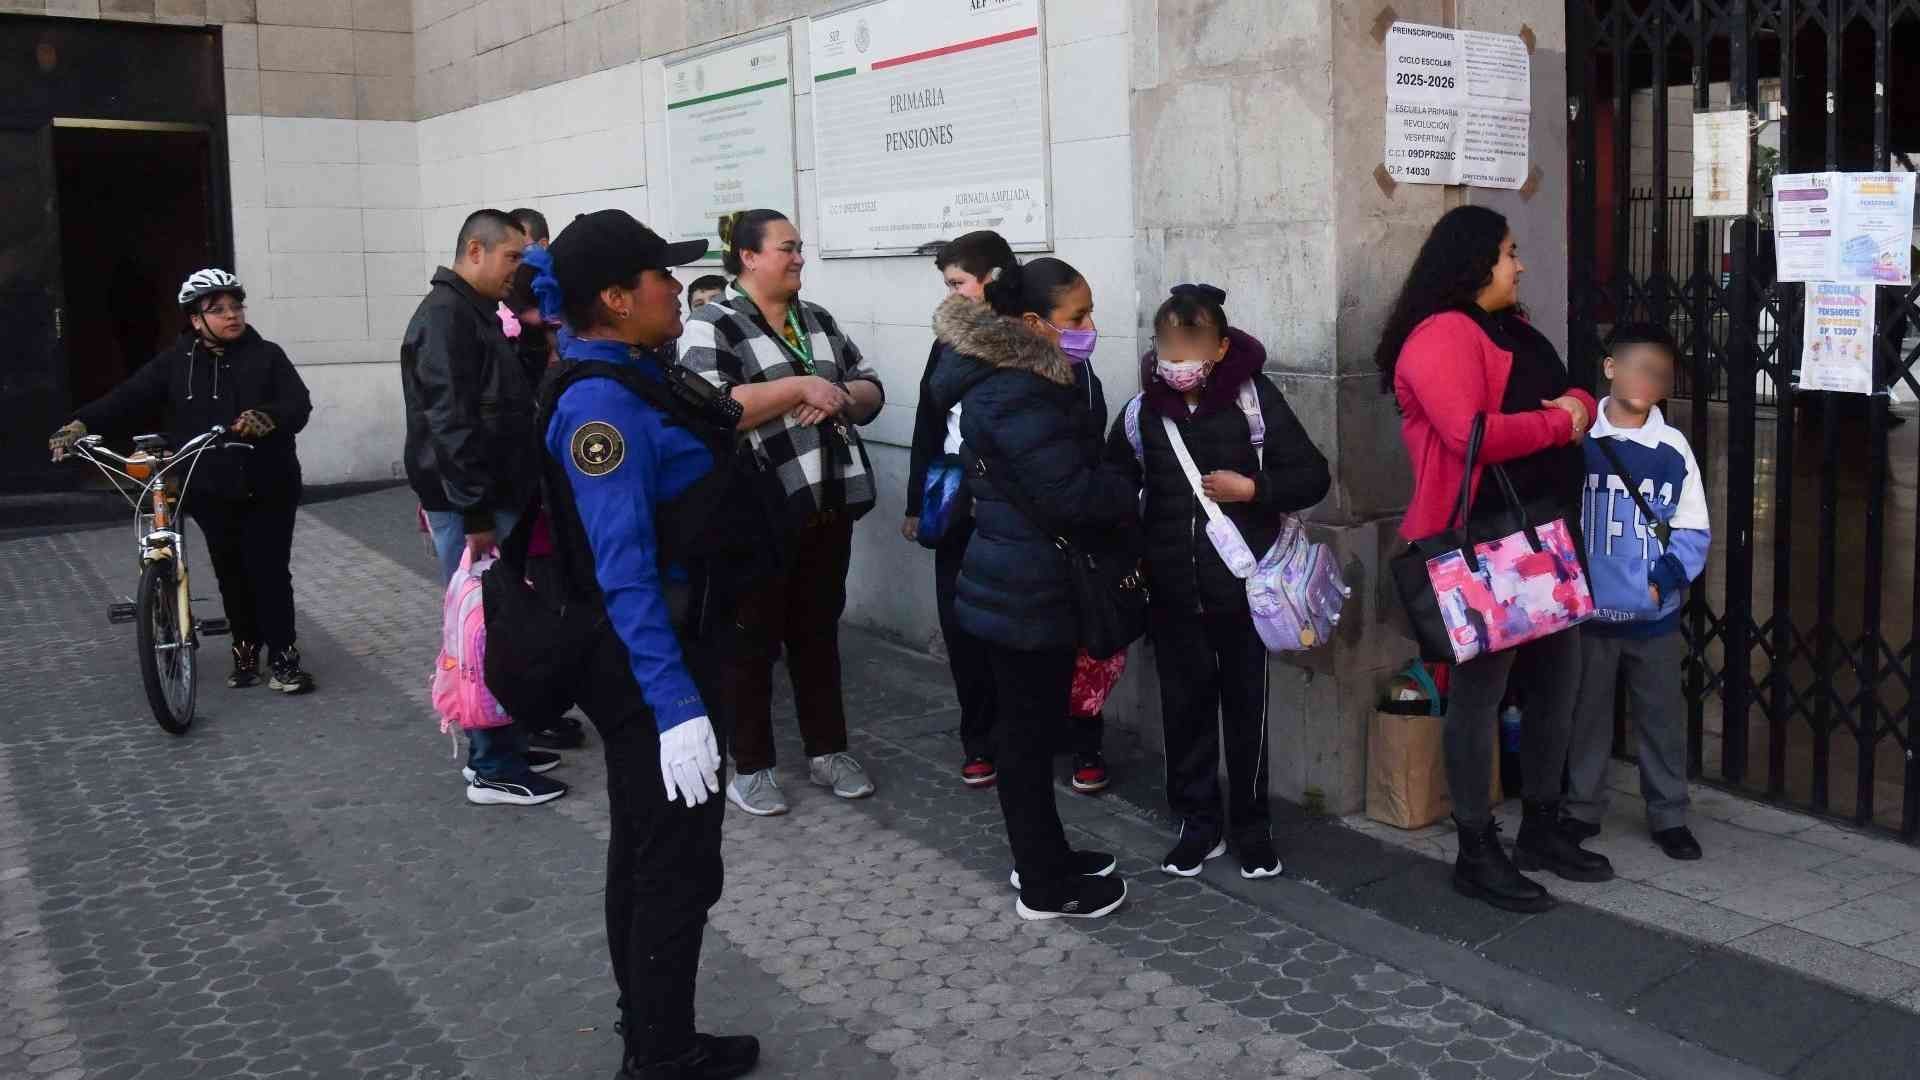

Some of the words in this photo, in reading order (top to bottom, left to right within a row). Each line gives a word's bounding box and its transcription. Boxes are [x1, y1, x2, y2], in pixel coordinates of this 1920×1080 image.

[1392, 26, 1455, 41] PREINSCRIPCIONES
[1398, 55, 1420, 65] CICLO
[1421, 57, 1452, 67] ESCOLAR
[1396, 72, 1455, 89] 2025-2026
[889, 87, 945, 113] PRIMARIA
[1395, 104, 1427, 114] ESCUELA
[1427, 107, 1459, 117] PRIMARIA
[1403, 119, 1450, 130] REVOLUCIÓN
[885, 123, 953, 152] PENSIONES
[1405, 167, 1430, 177] 14030
[990, 187, 1031, 203] AMPLIADA
